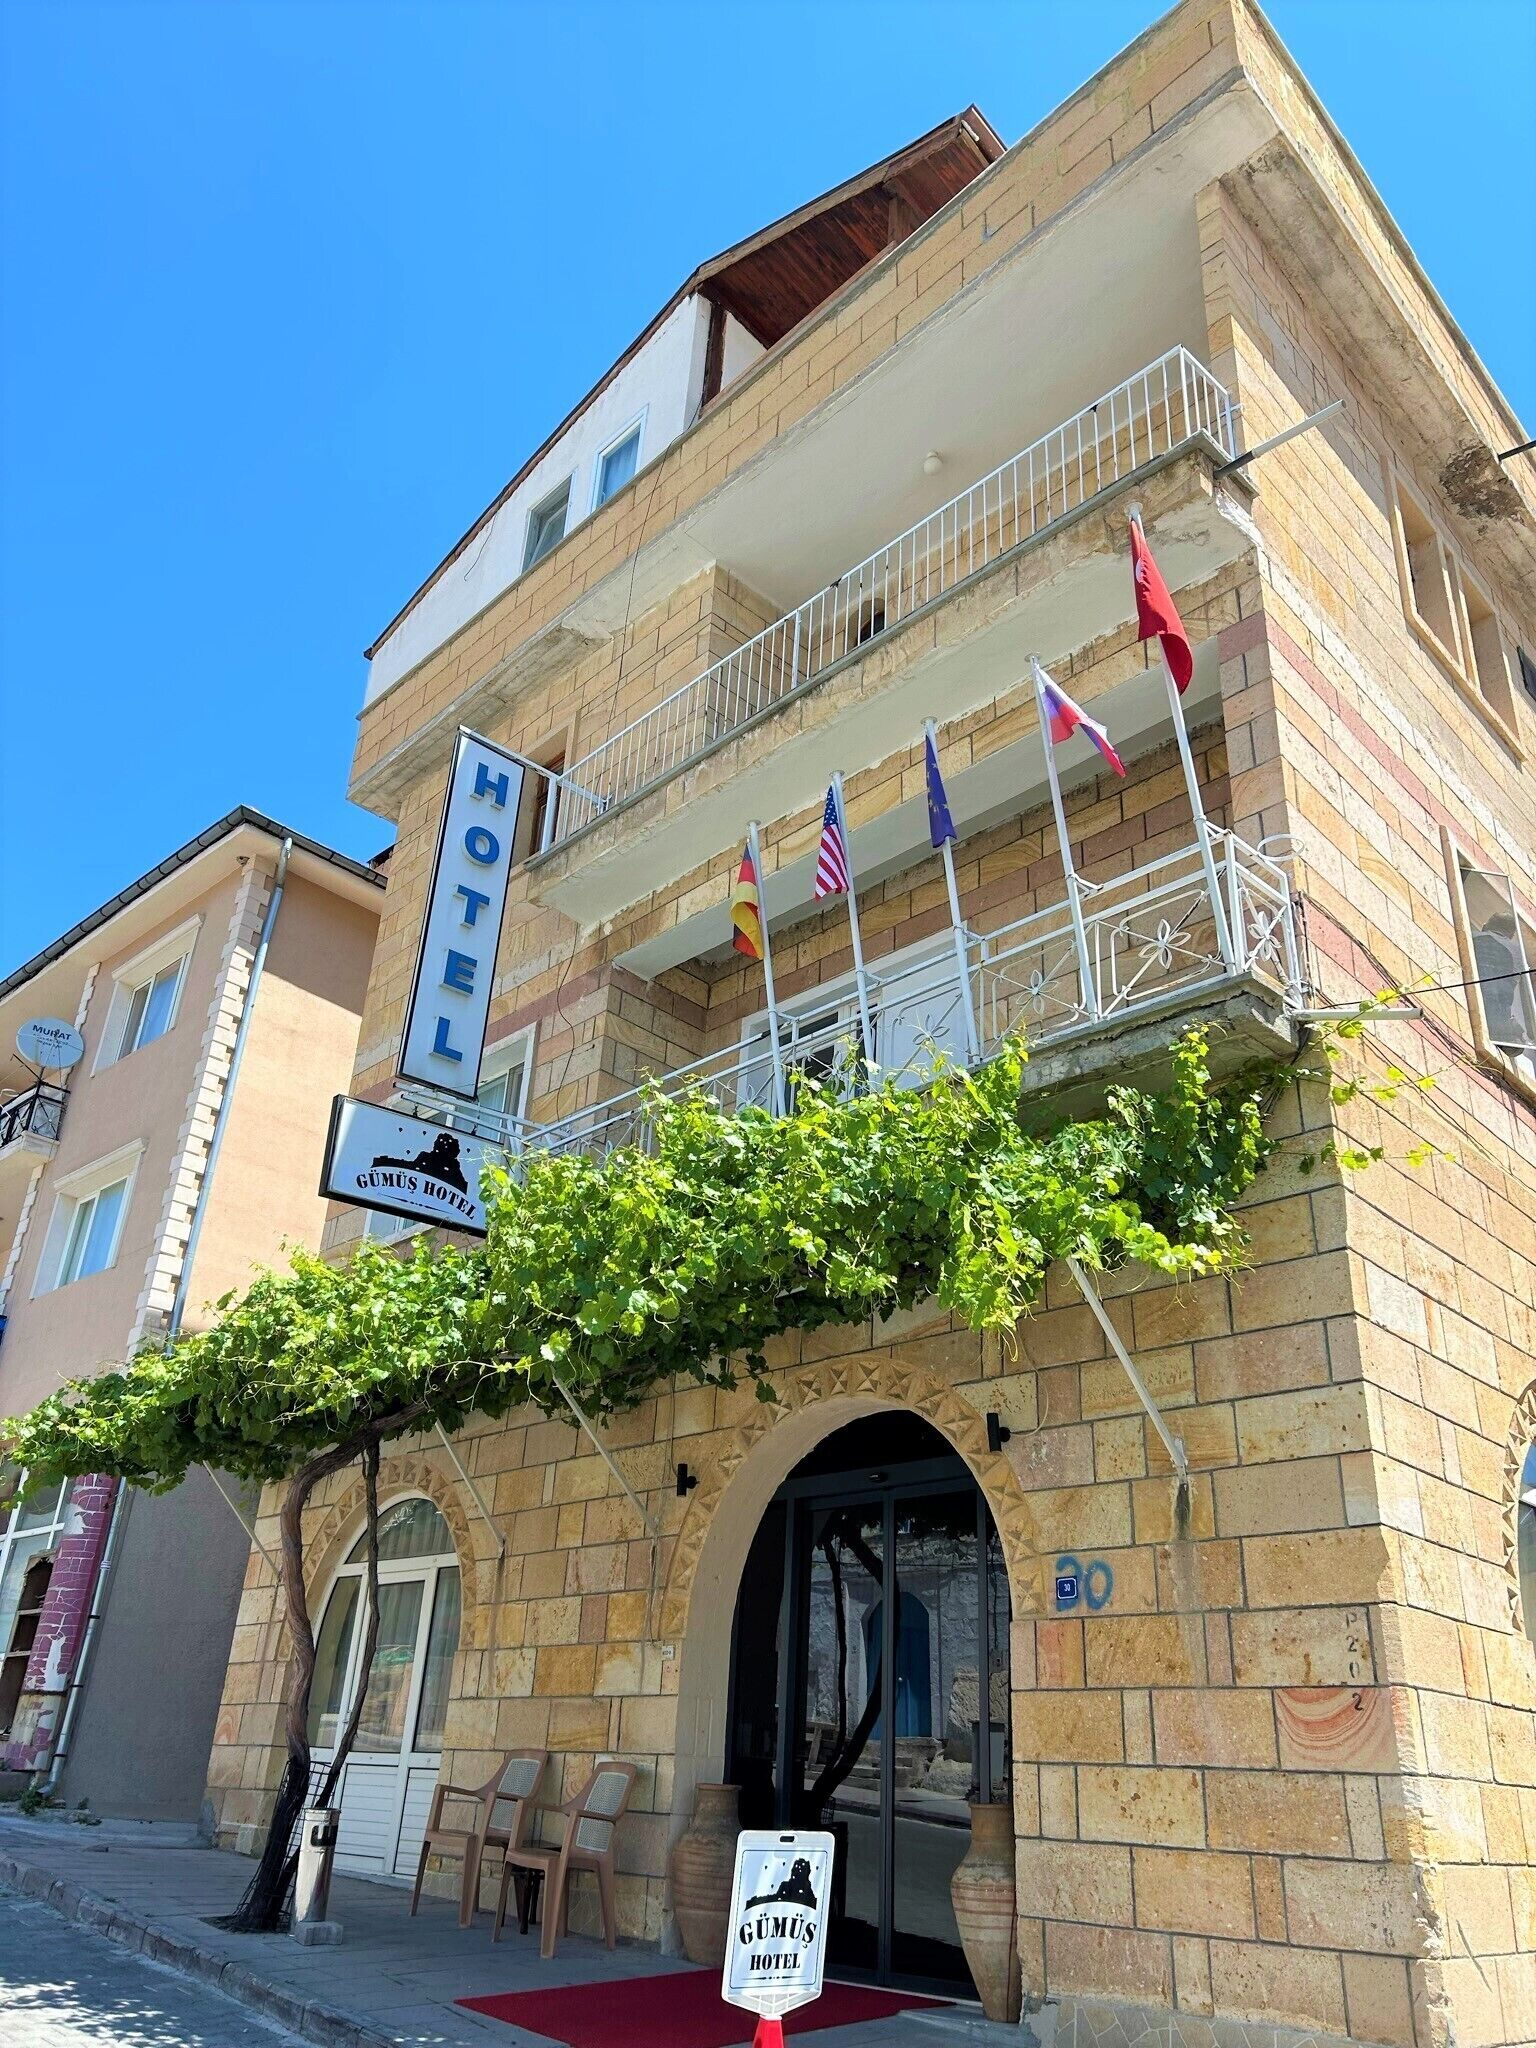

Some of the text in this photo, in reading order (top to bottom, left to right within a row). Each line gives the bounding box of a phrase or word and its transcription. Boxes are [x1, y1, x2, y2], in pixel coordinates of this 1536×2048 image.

[431, 761, 509, 1064] HOTEL
[356, 1169, 476, 1220] GÜMÜŞ HOTEL
[739, 1912, 818, 1949] GÜMÜŞ
[749, 1953, 801, 1971] HOTEL
